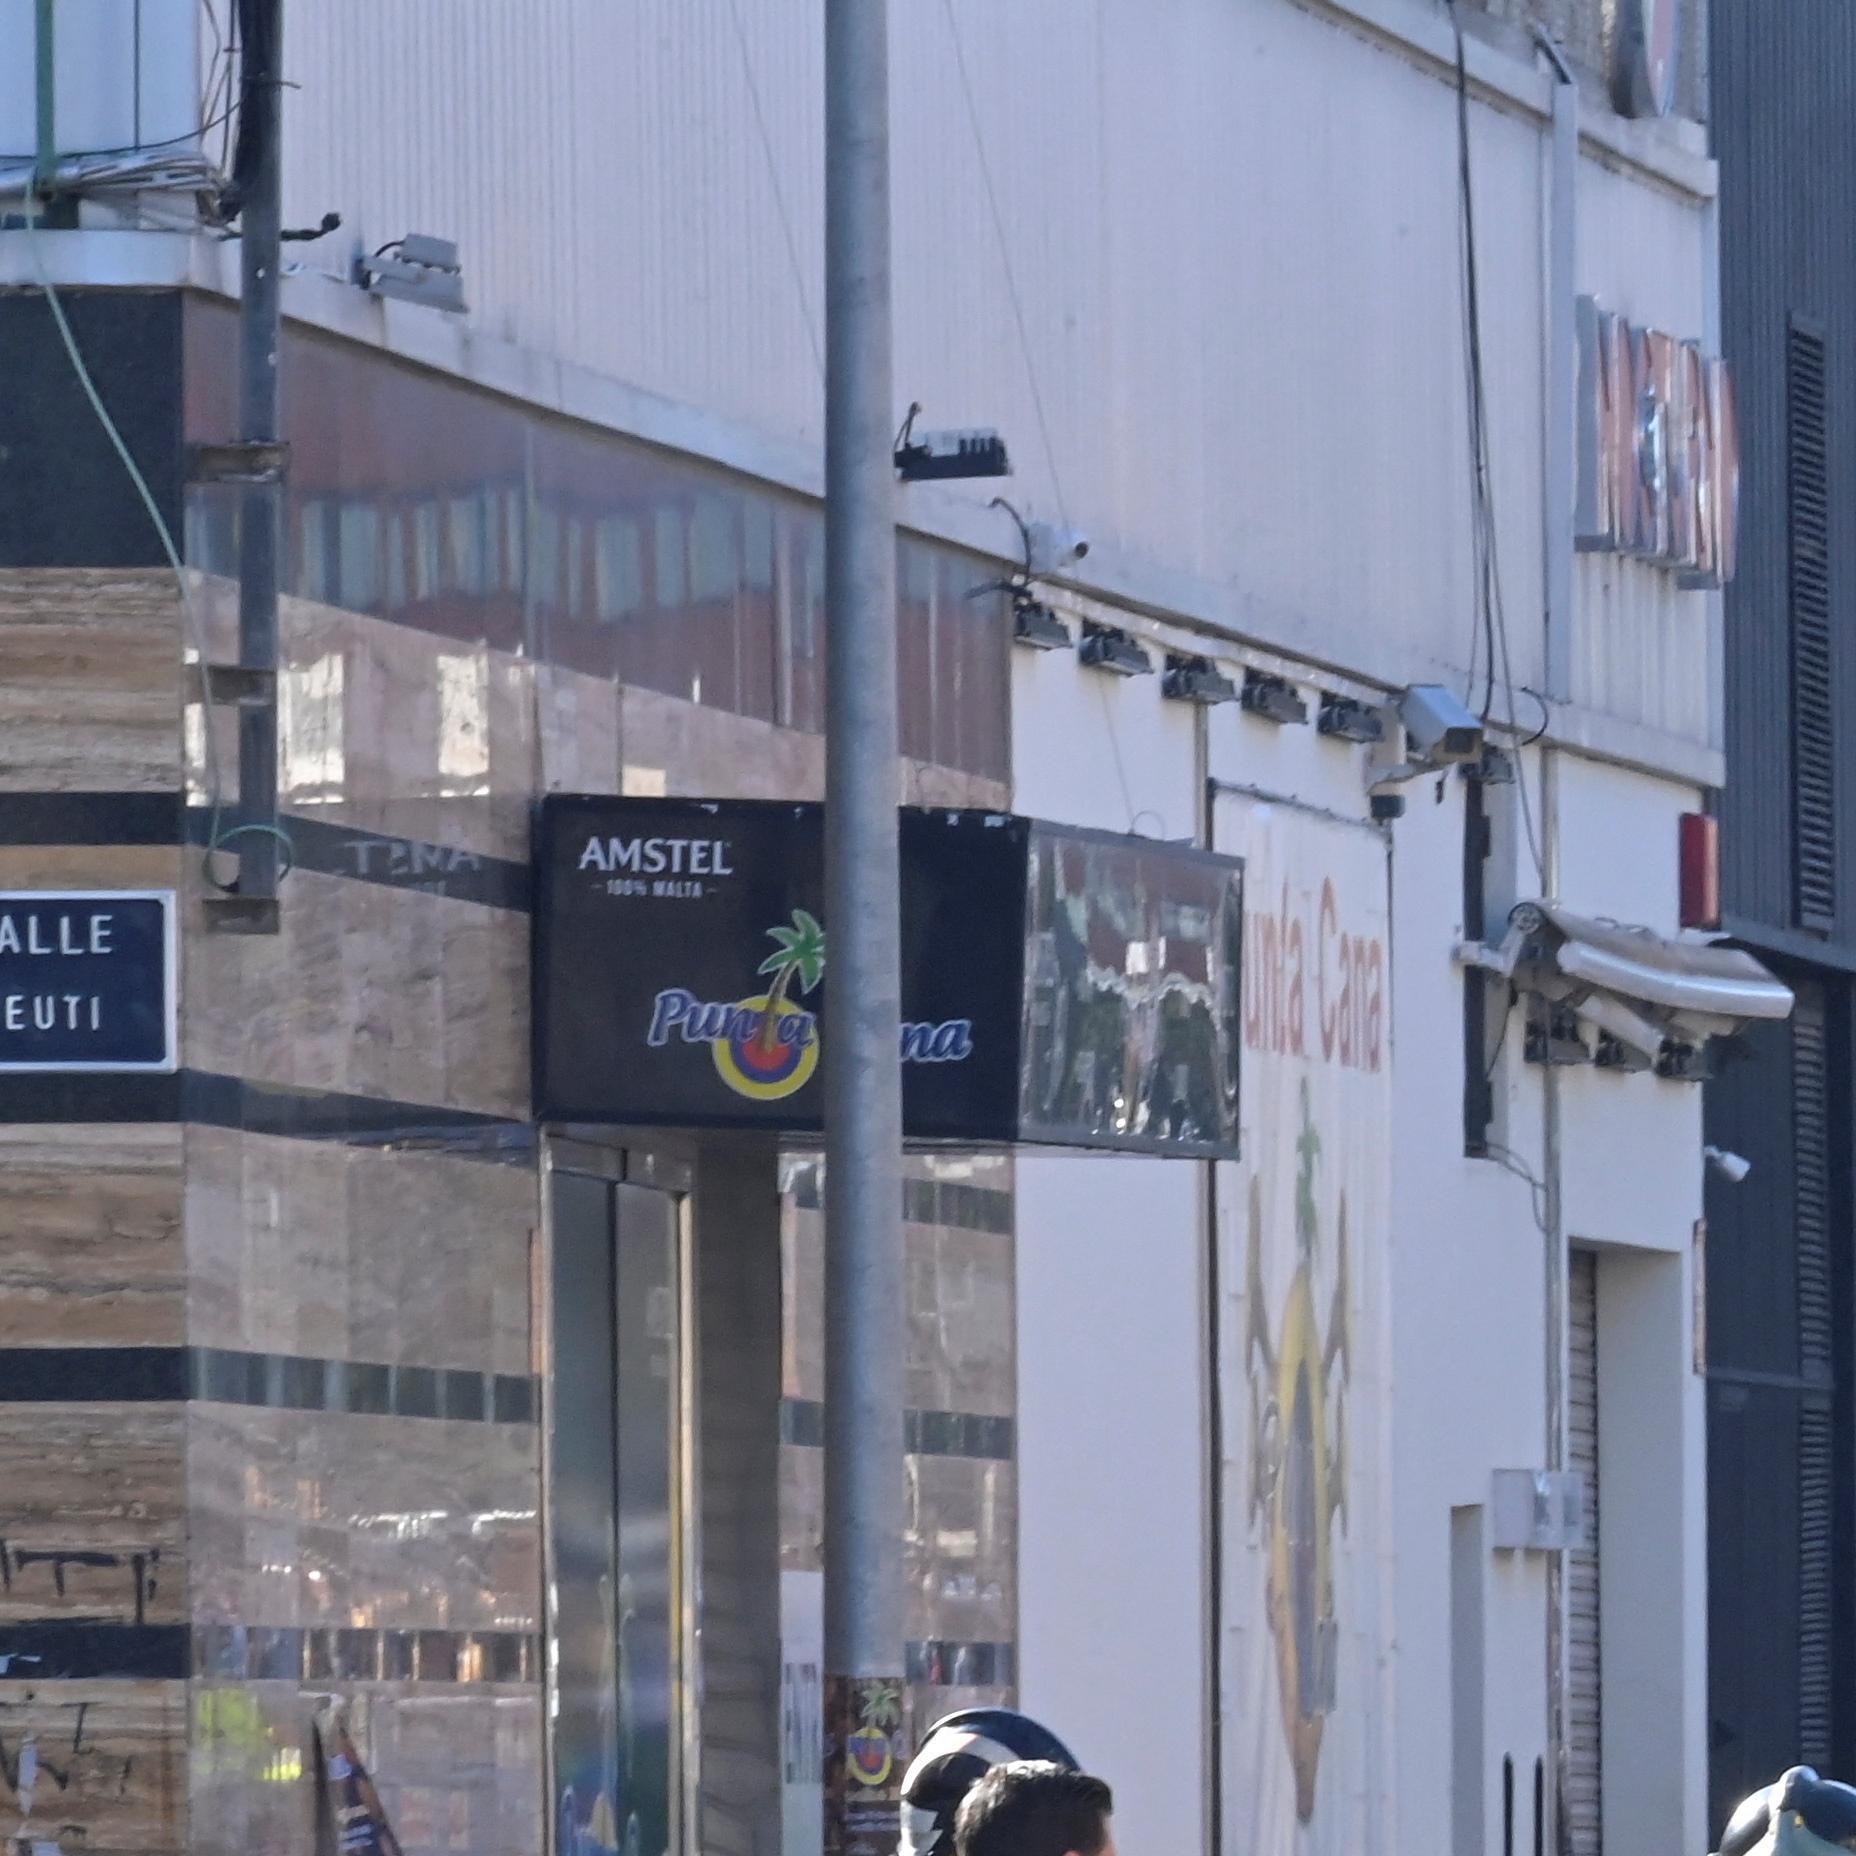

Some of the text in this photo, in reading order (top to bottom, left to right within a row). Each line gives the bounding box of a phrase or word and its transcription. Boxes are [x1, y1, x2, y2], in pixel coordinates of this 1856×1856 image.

[578, 836, 733, 875] AMSTEL
[606, 879, 703, 898] 100% MALTA
[1243, 877, 1382, 1073] unta Cana
[5, 995, 101, 1031] EUTI
[900, 1019, 974, 1063] na
